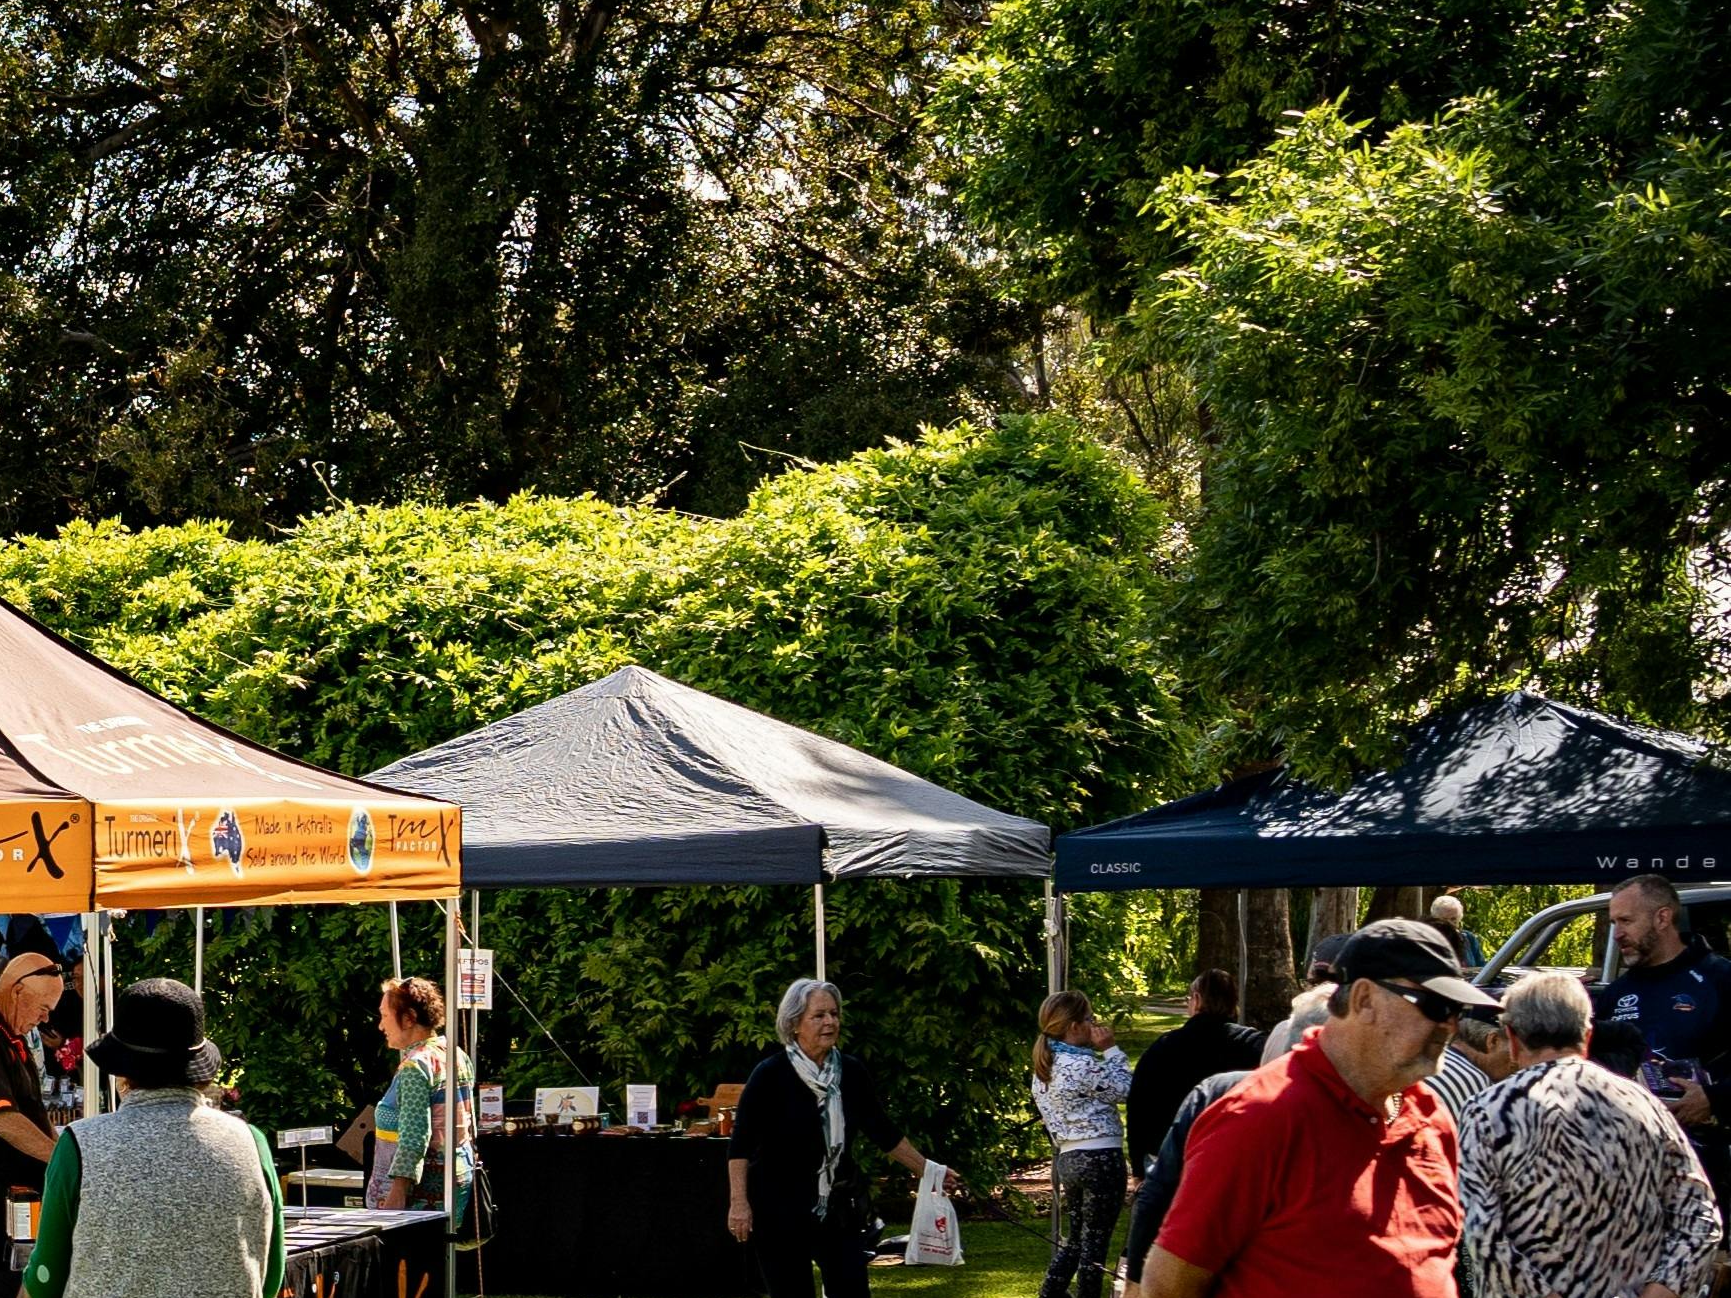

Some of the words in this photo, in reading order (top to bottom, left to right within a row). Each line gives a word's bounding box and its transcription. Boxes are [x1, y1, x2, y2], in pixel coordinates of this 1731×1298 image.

[255, 816, 281, 836] Made
[284, 815, 293, 834] in
[296, 814, 333, 835] Australia
[395, 840, 437, 852] FACTOR
[246, 847, 267, 869] Sold
[269, 849, 298, 867] around
[300, 846, 317, 866] the
[319, 845, 346, 866] World
[1090, 862, 1141, 874] CLASSIC
